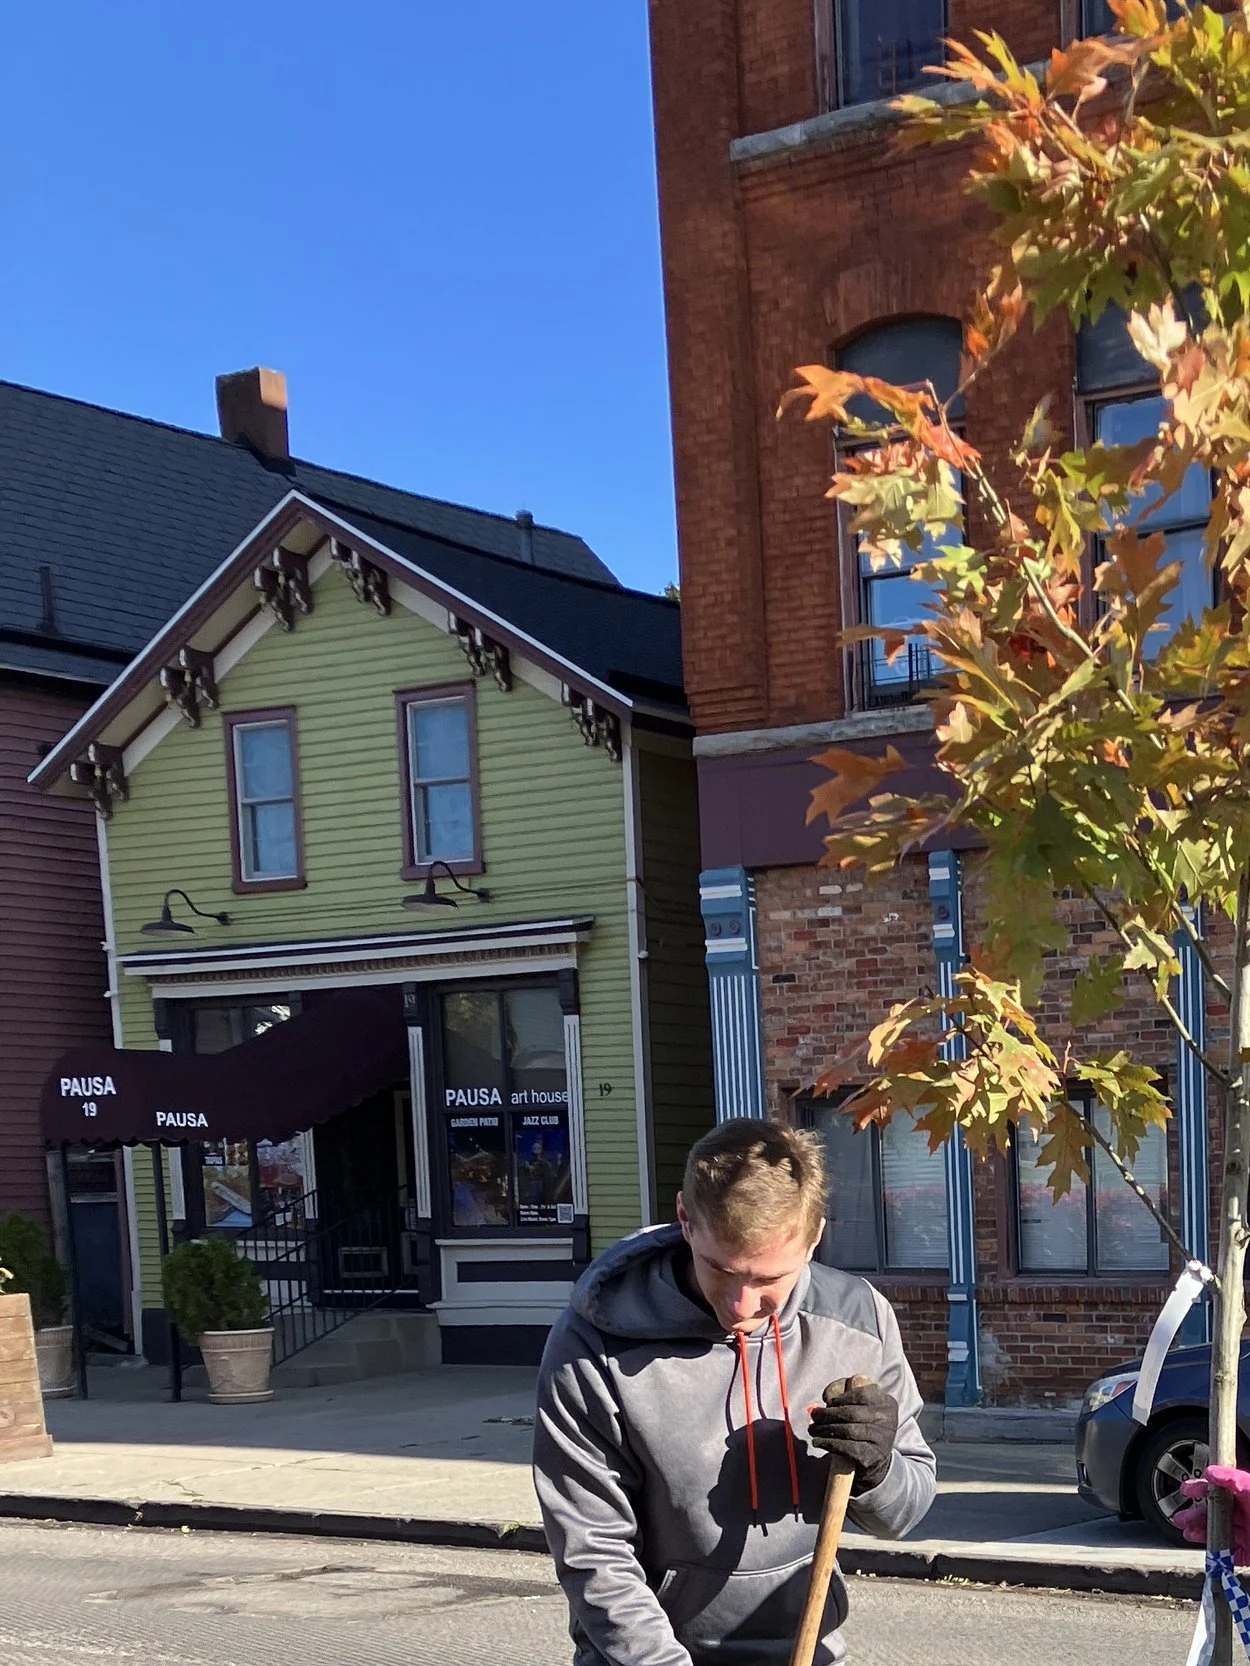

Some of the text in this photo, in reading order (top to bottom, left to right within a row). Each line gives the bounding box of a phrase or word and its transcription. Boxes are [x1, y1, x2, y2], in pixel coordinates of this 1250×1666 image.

[60, 1076, 117, 1097] PAUSA
[600, 1083, 612, 1097] 19
[445, 1087, 569, 1106] PAUSA art house
[82, 1102, 98, 1117] 19
[156, 1112, 209, 1128] PAUSA
[479, 1117, 499, 1127] PATIO
[522, 1116, 560, 1126] JAZZ CLUB
